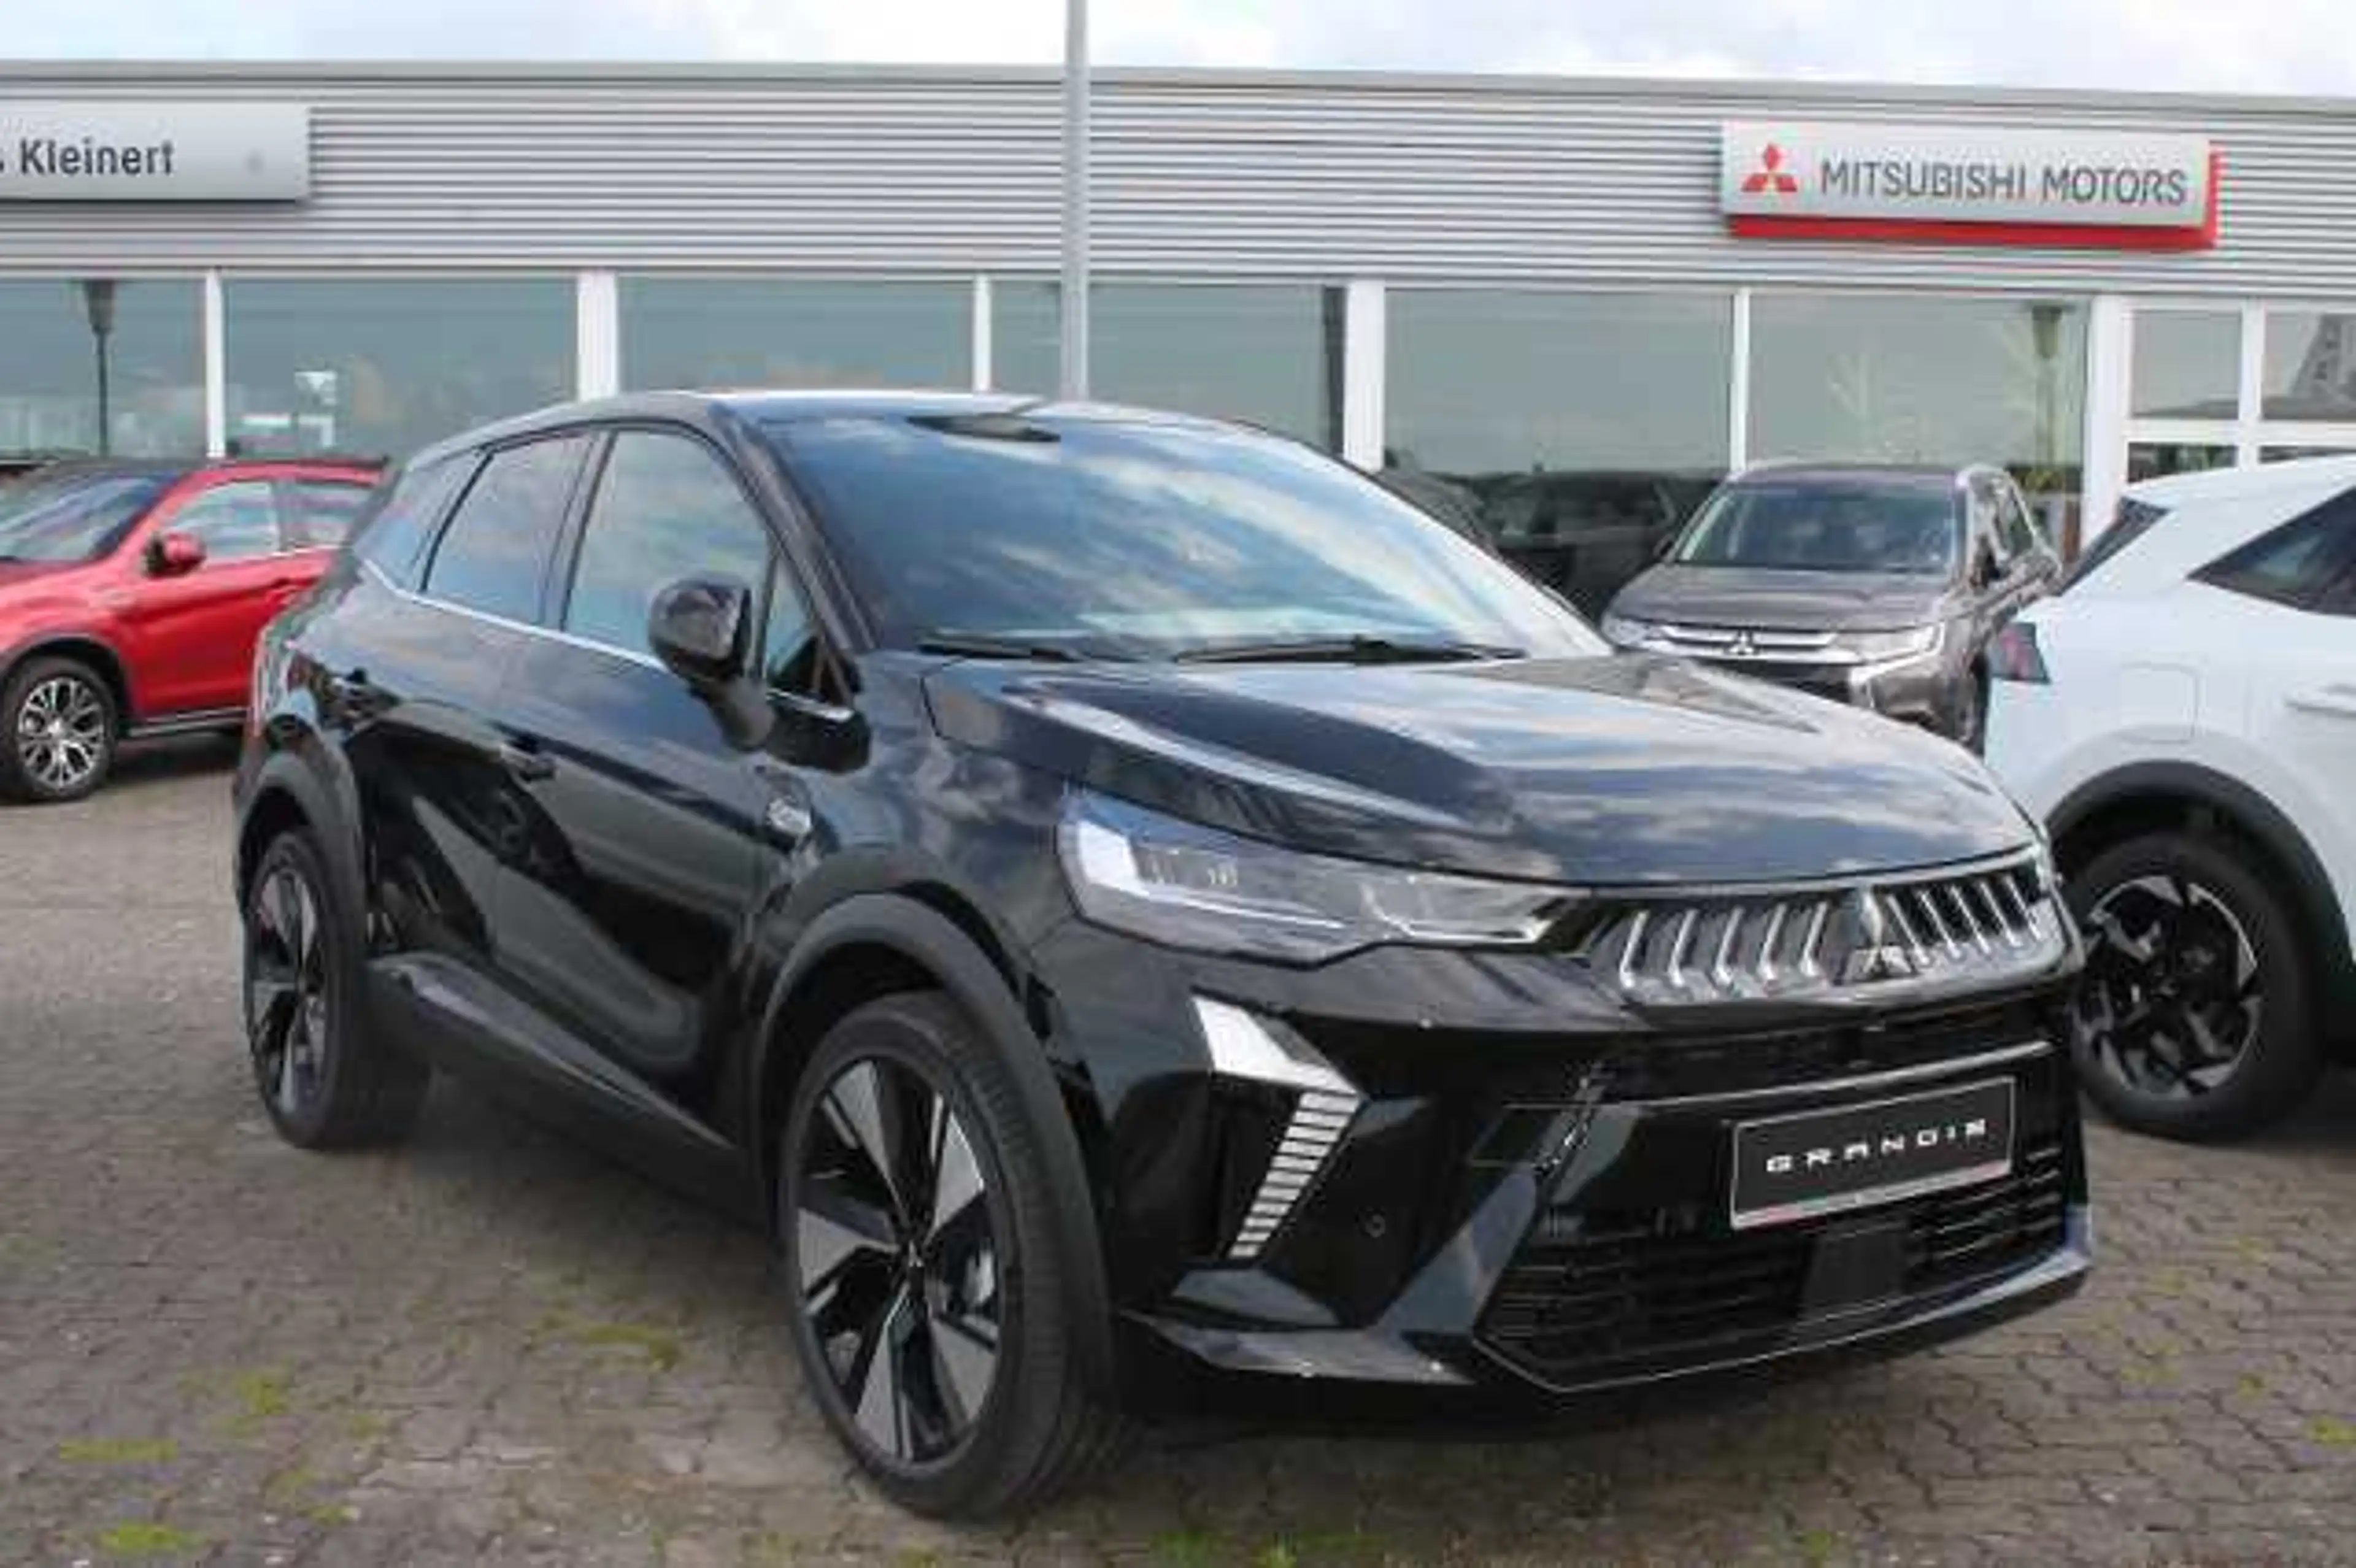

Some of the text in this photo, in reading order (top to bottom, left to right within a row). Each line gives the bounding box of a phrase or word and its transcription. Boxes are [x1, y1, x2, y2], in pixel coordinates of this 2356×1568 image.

[19, 136, 174, 175] Kleinert
[1820, 158, 2188, 206] MITSUBISHI MOTORS
